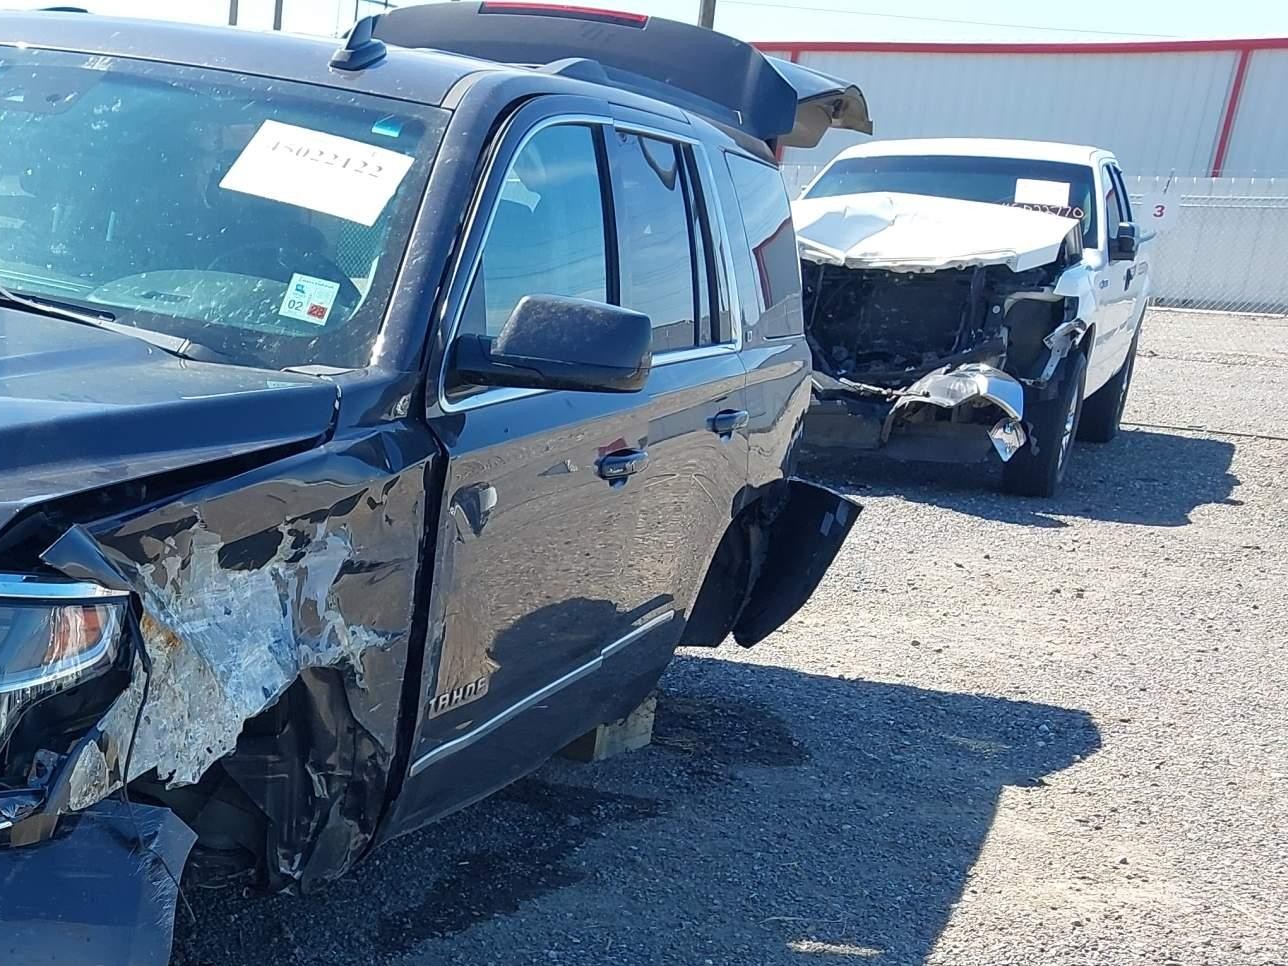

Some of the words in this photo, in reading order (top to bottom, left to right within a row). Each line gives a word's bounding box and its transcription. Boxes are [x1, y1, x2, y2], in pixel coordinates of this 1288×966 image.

[1152, 204, 1166, 218] 3
[287, 299, 304, 312] 02
[428, 676, 488, 714] TAHOE
